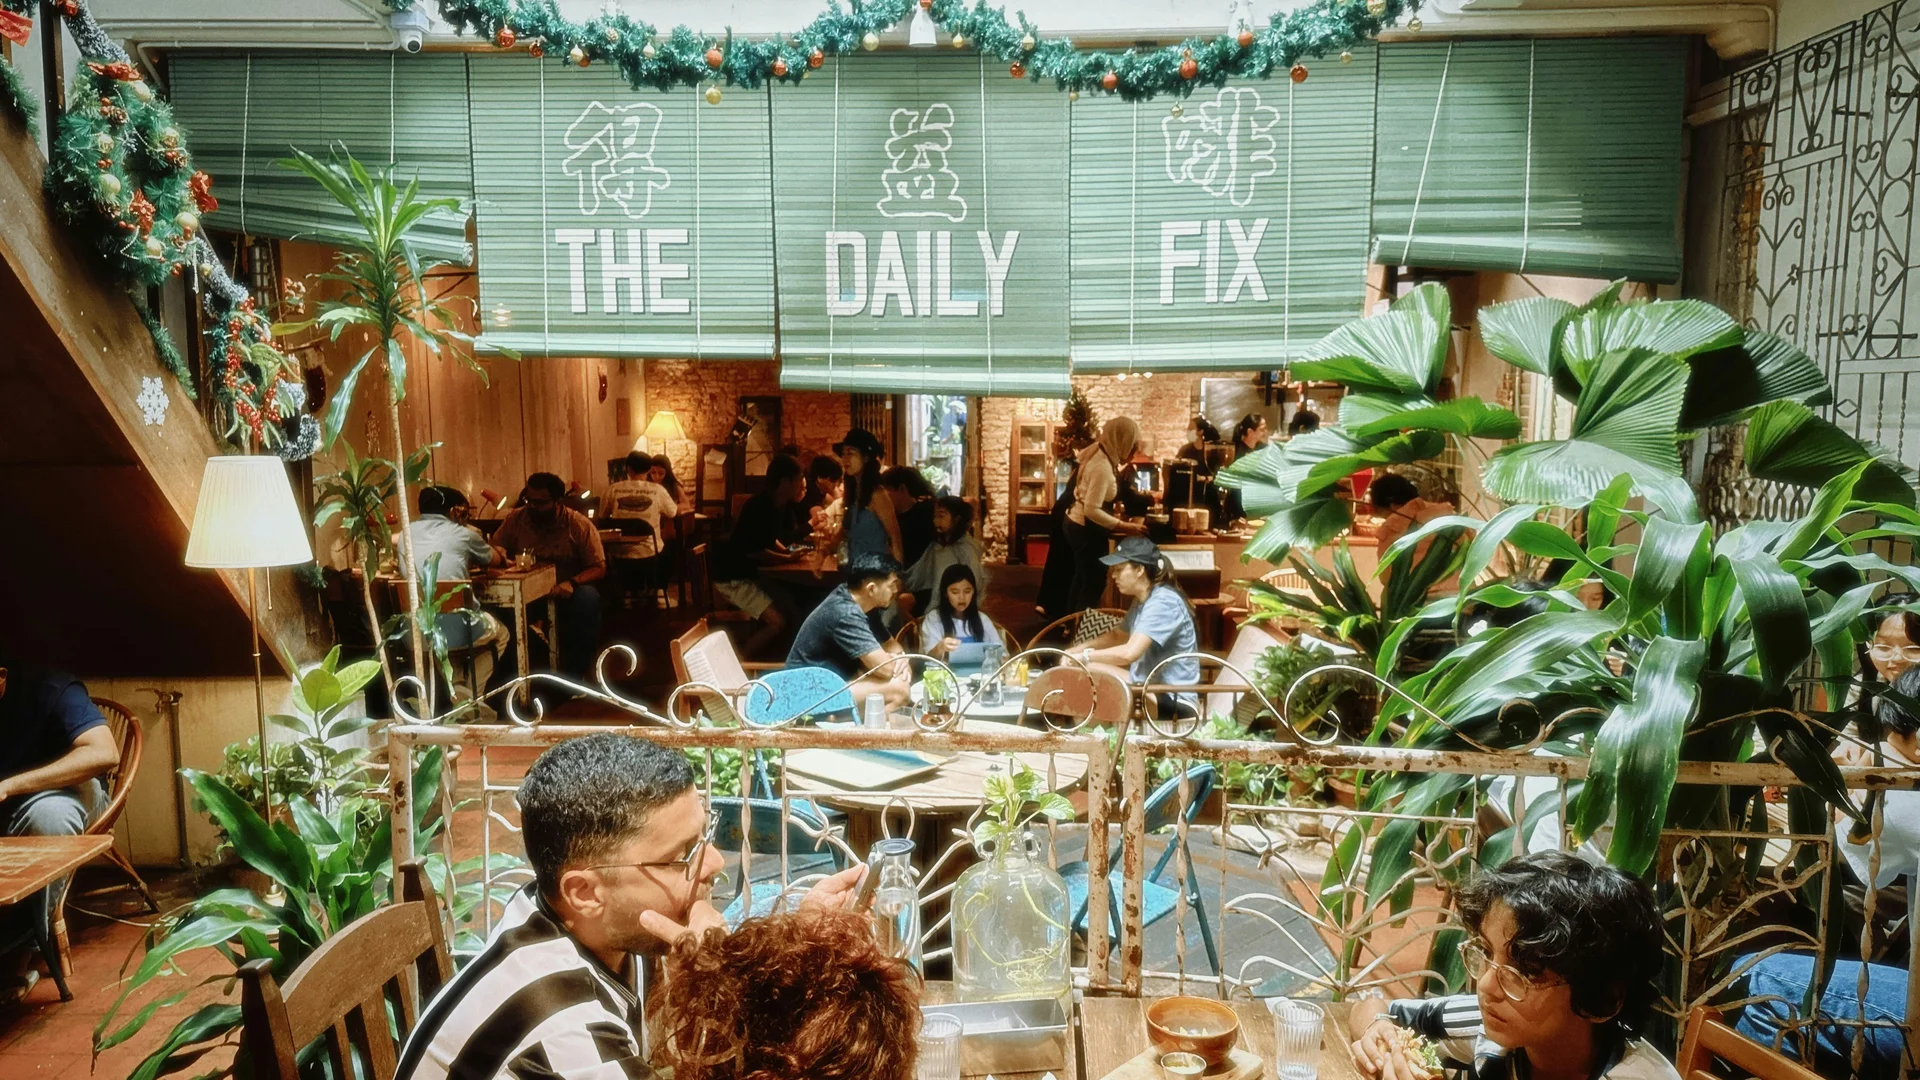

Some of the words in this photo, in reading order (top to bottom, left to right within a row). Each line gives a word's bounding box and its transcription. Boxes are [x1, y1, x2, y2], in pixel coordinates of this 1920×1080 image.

[562, 101, 671, 219] 得
[554, 228, 691, 315] THE
[825, 230, 1020, 317] DAILY
[1159, 217, 1270, 305] FIX
